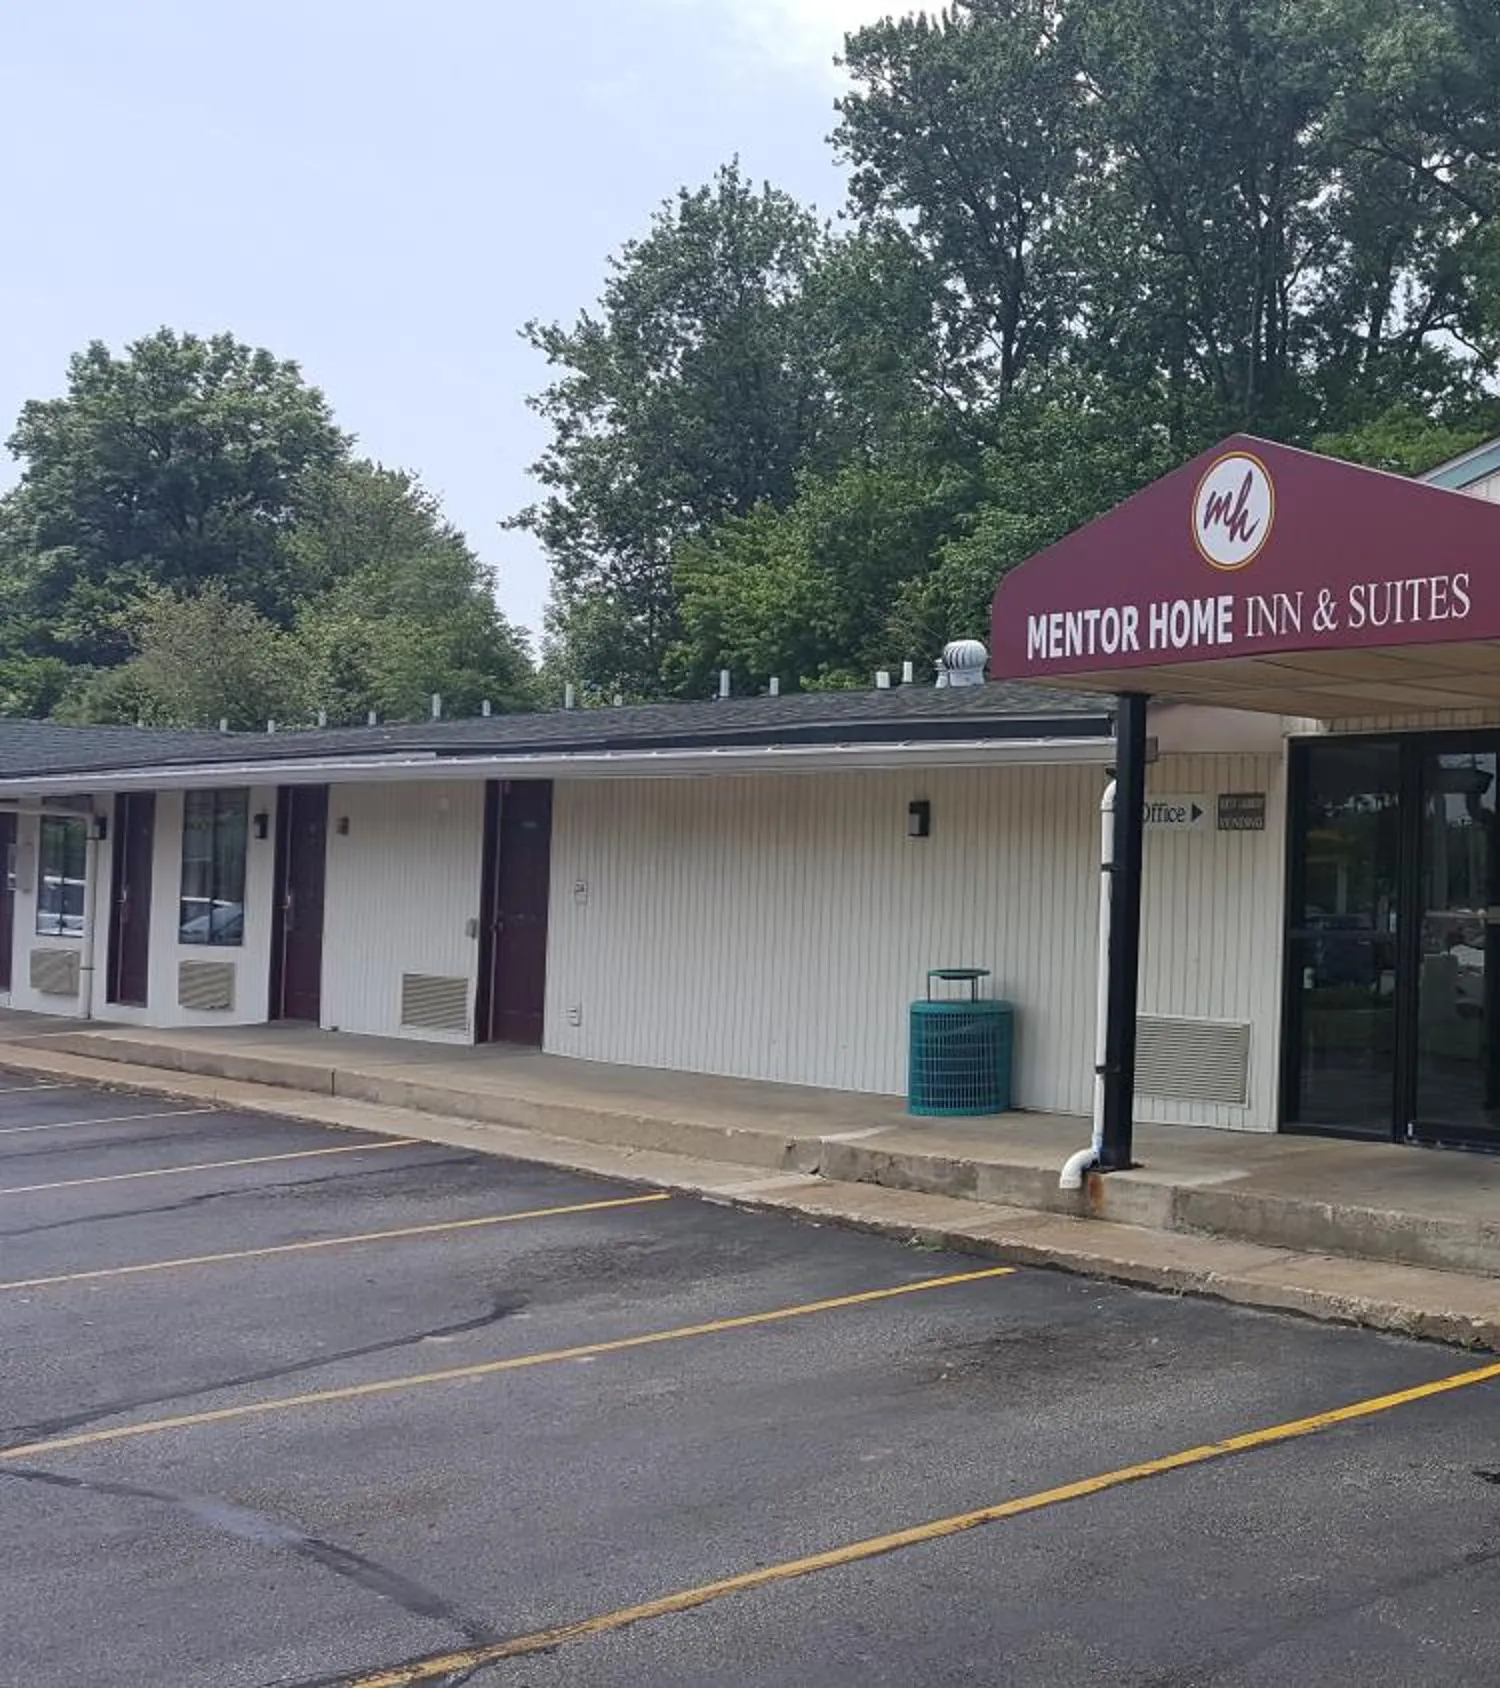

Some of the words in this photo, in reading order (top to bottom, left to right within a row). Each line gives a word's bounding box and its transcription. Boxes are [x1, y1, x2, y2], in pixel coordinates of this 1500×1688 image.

[1027, 604, 1141, 660] MENTOR
[1148, 594, 1234, 649] HOME
[1245, 590, 1303, 638] INN
[1312, 588, 1338, 632] &
[1348, 572, 1472, 629] SUITES
